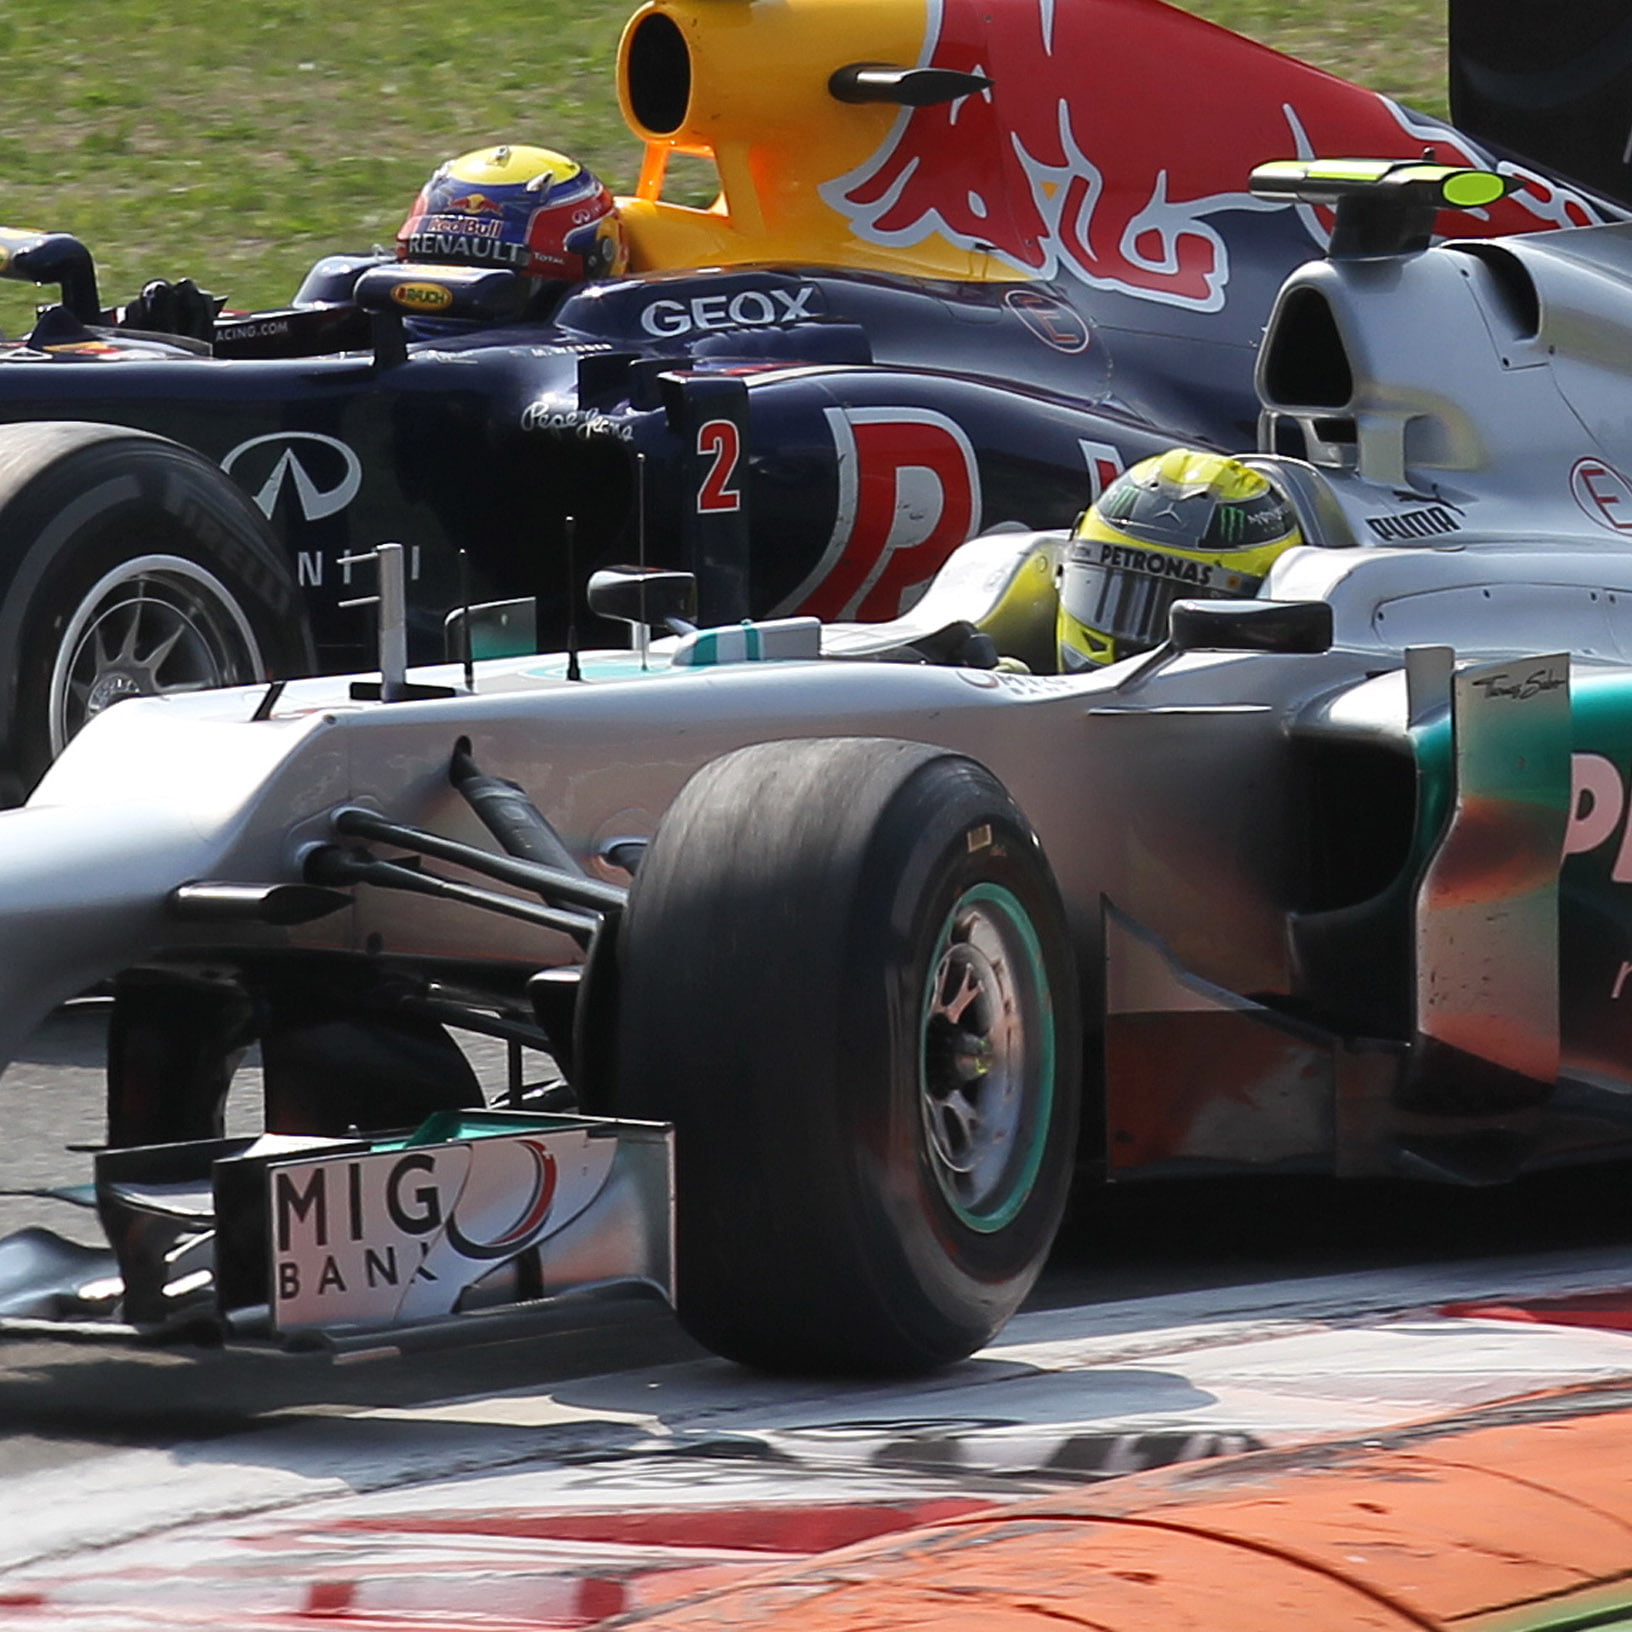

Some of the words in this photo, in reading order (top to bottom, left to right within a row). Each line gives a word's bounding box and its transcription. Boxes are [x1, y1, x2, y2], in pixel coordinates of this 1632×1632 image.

[408, 232, 525, 263] RENAULT
[464, 217, 503, 239] Bull
[640, 285, 815, 339] GEOX
[695, 418, 742, 515] 2
[1365, 506, 1461, 542] PUMA
[1100, 543, 1213, 586] PETRONAS
[277, 1153, 442, 1252] MIG
